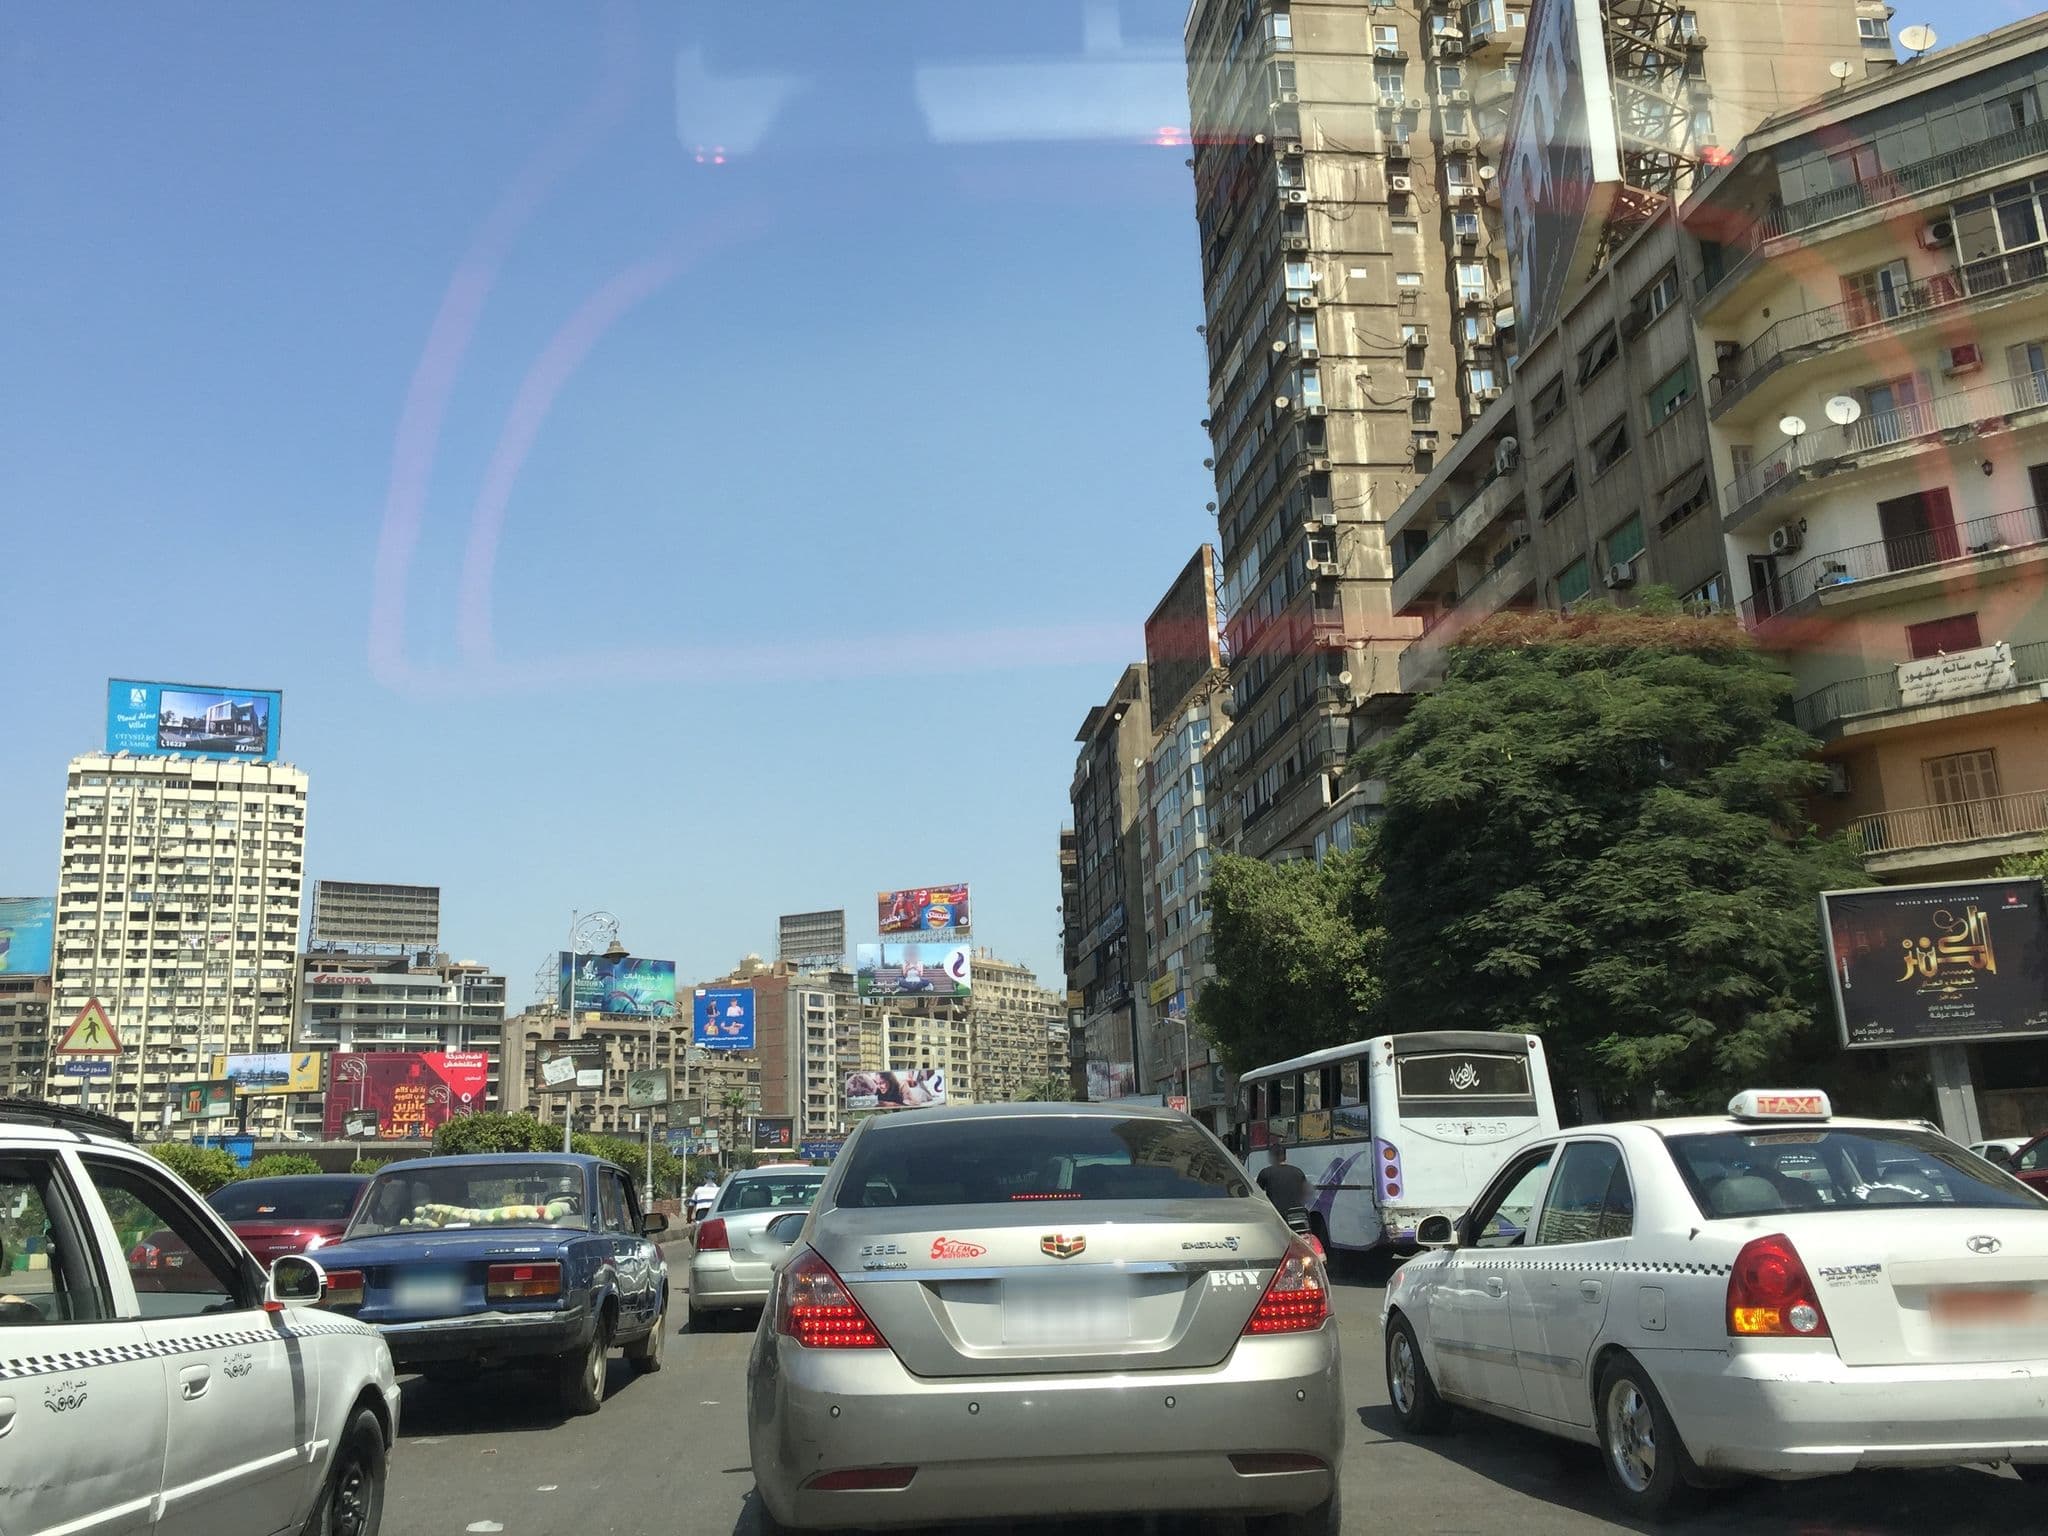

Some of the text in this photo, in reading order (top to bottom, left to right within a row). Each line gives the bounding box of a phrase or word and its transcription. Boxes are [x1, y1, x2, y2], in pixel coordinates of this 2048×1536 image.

[1904, 653, 2006, 683] كريم سالم مشهور
[1758, 1097, 1822, 1113] TAXI
[1210, 1271, 1261, 1286] EGY
